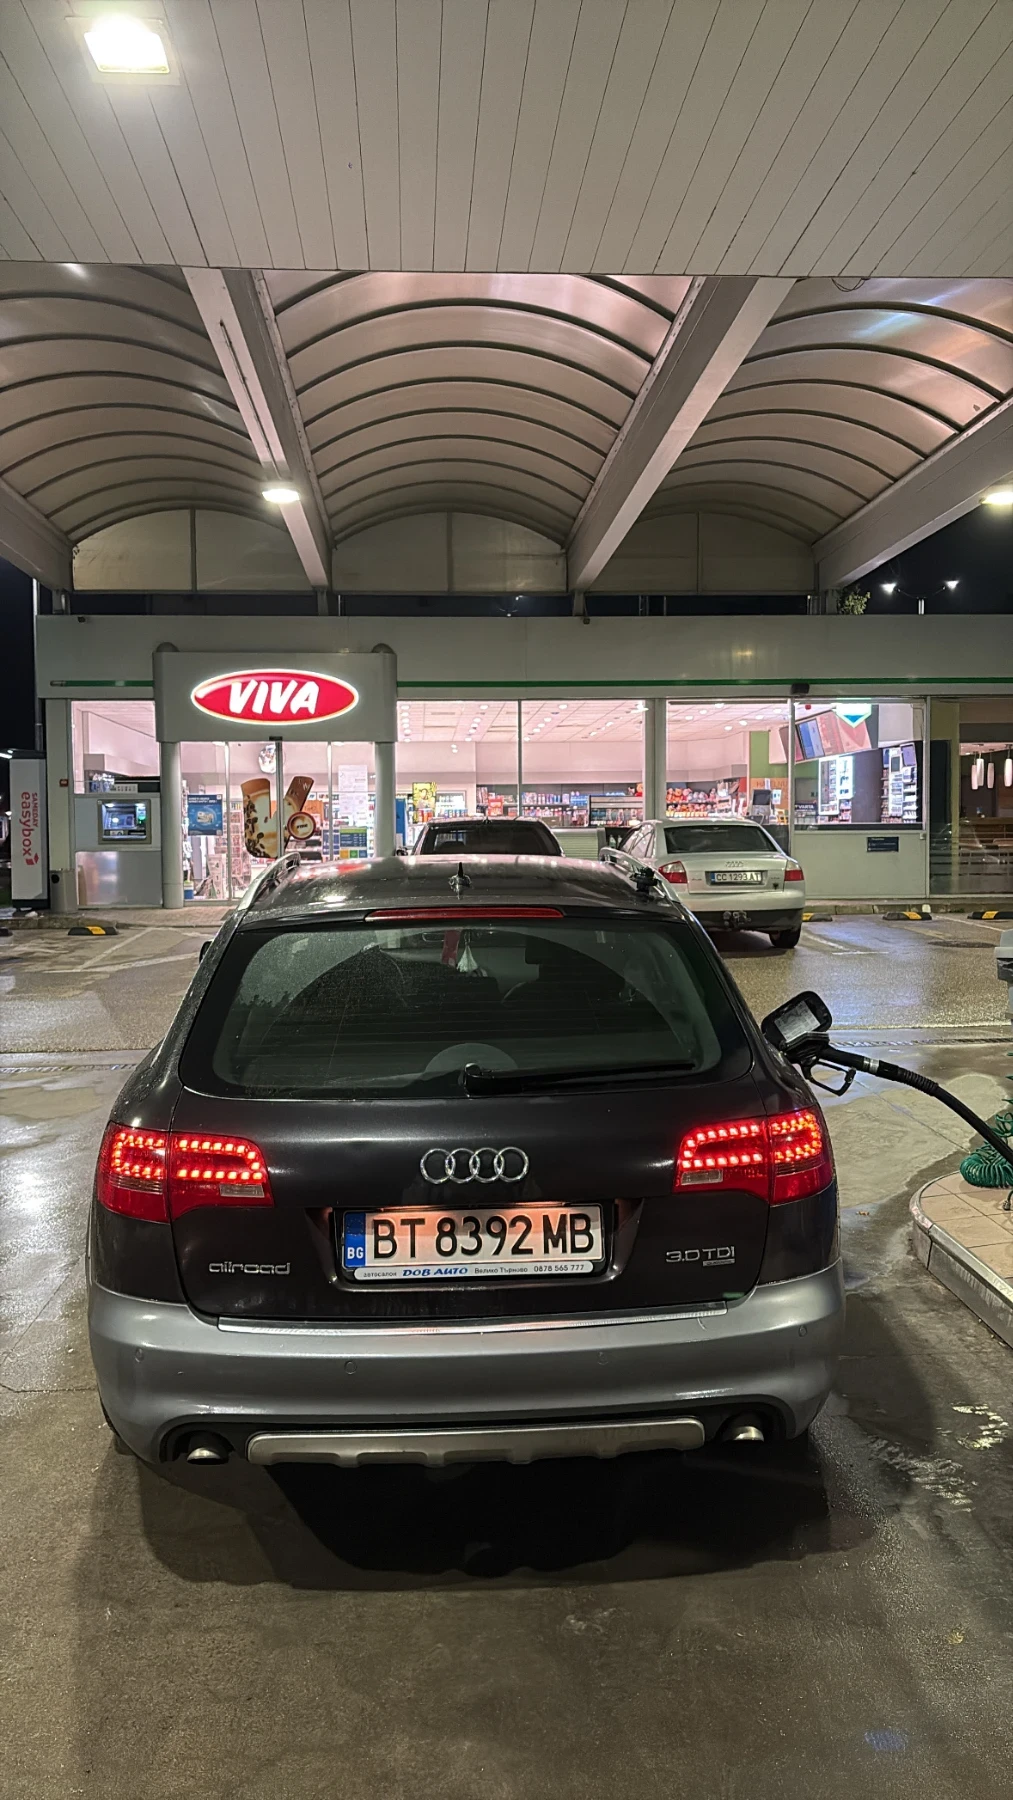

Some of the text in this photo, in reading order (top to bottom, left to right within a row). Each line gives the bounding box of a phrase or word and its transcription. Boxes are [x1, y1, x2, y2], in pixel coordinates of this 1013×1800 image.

[228, 678, 320, 715] VIVA
[19, 791, 35, 857] easybox
[716, 873, 727, 881] CC
[729, 872, 748, 881] 1293
[749, 872, 760, 881] AT
[373, 1213, 594, 1259] BT 8392 MB
[347, 1247, 365, 1259] BG
[665, 1249, 700, 1263] 3.0
[702, 1246, 735, 1260] TDI
[208, 1261, 291, 1275] allroad
[402, 1268, 431, 1277] DOB
[433, 1267, 468, 1275] AUTO
[499, 1266, 528, 1274] Търново
[533, 1265, 553, 1273] 0878
[554, 1264, 569, 1272] 565
